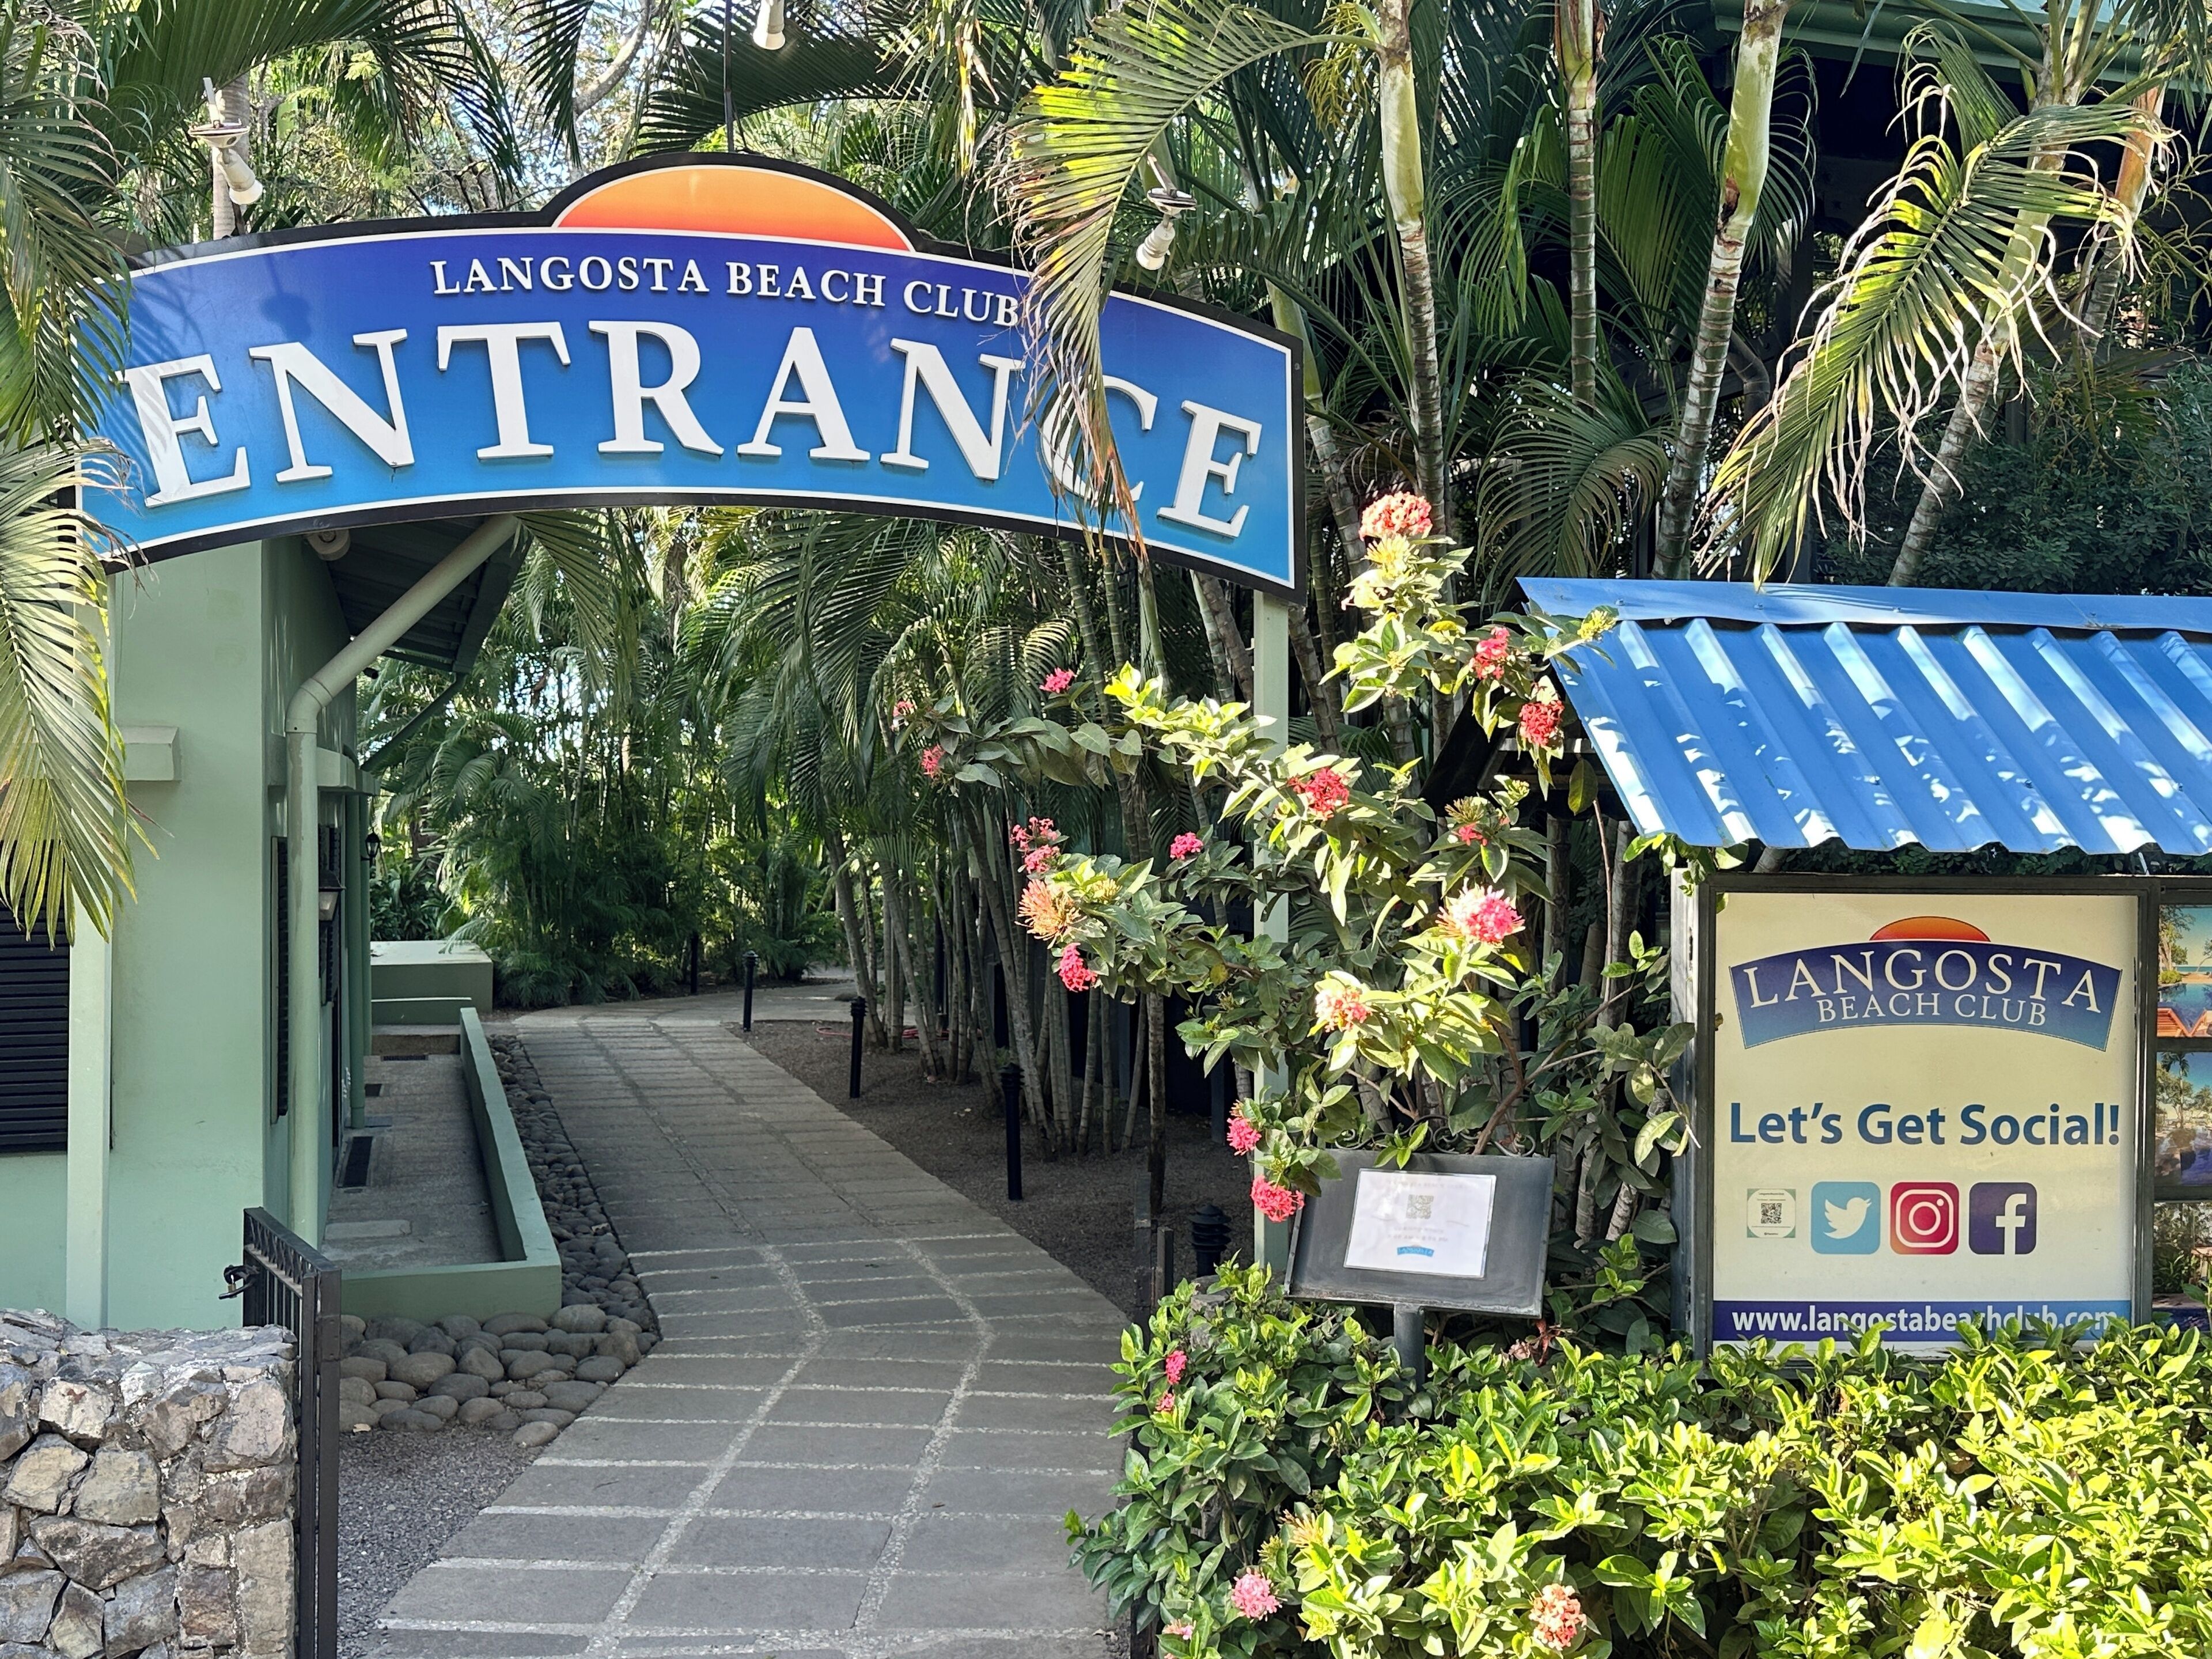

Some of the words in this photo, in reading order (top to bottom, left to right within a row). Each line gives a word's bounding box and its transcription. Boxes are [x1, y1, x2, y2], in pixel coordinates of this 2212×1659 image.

[430, 255, 710, 294] LANGOSTA
[726, 260, 887, 306] BEACH
[903, 280, 1018, 327] CLUB
[108, 320, 1263, 539] ENTRANCE
[1743, 949, 2102, 1014] LANGOSTA
[1817, 993, 1941, 1023] BEACH
[1955, 994, 2047, 1027] CLUB
[1730, 1103, 1843, 1144] Let’s
[1857, 1104, 1946, 1145] Get
[1960, 1103, 2120, 1145] Social!
[1732, 1305, 2117, 1338] www.langostabeahclub.com
